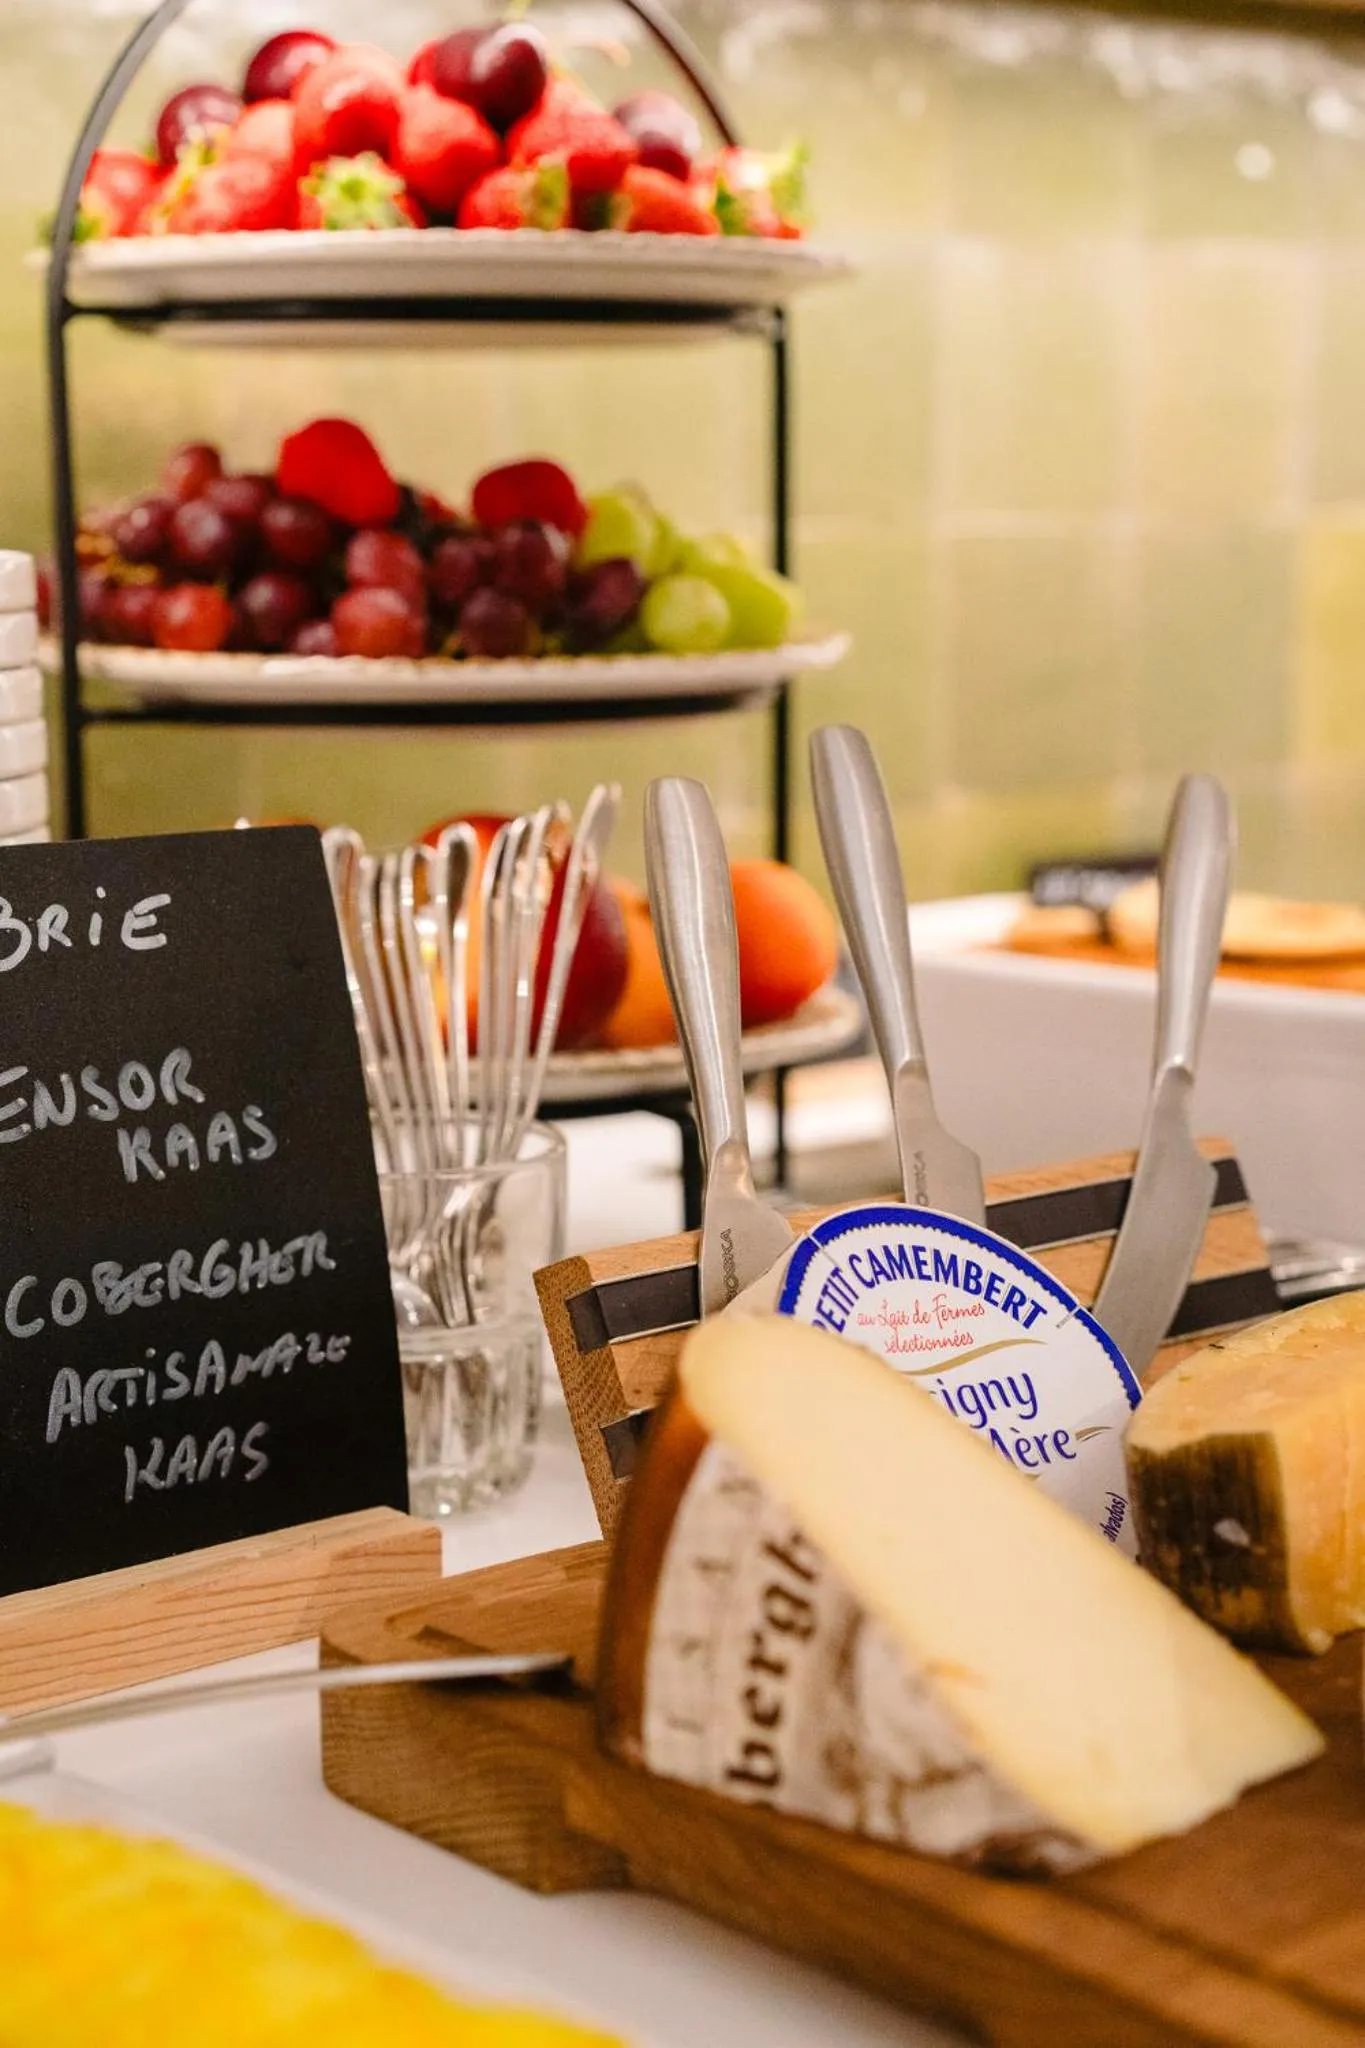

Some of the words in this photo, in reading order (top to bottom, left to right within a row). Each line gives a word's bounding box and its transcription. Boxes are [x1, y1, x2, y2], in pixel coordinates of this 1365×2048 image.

[117, 1104, 278, 1183] KAAS
[848, 1243, 1048, 1331] CAMEMBERT
[912, 1299, 931, 1326] de
[931, 1293, 986, 1330] Fermes
[930, 1372, 1039, 1429] igny
[124, 1420, 271, 1504] KAAS
[1098, 1491, 1129, 1543] alvados)
